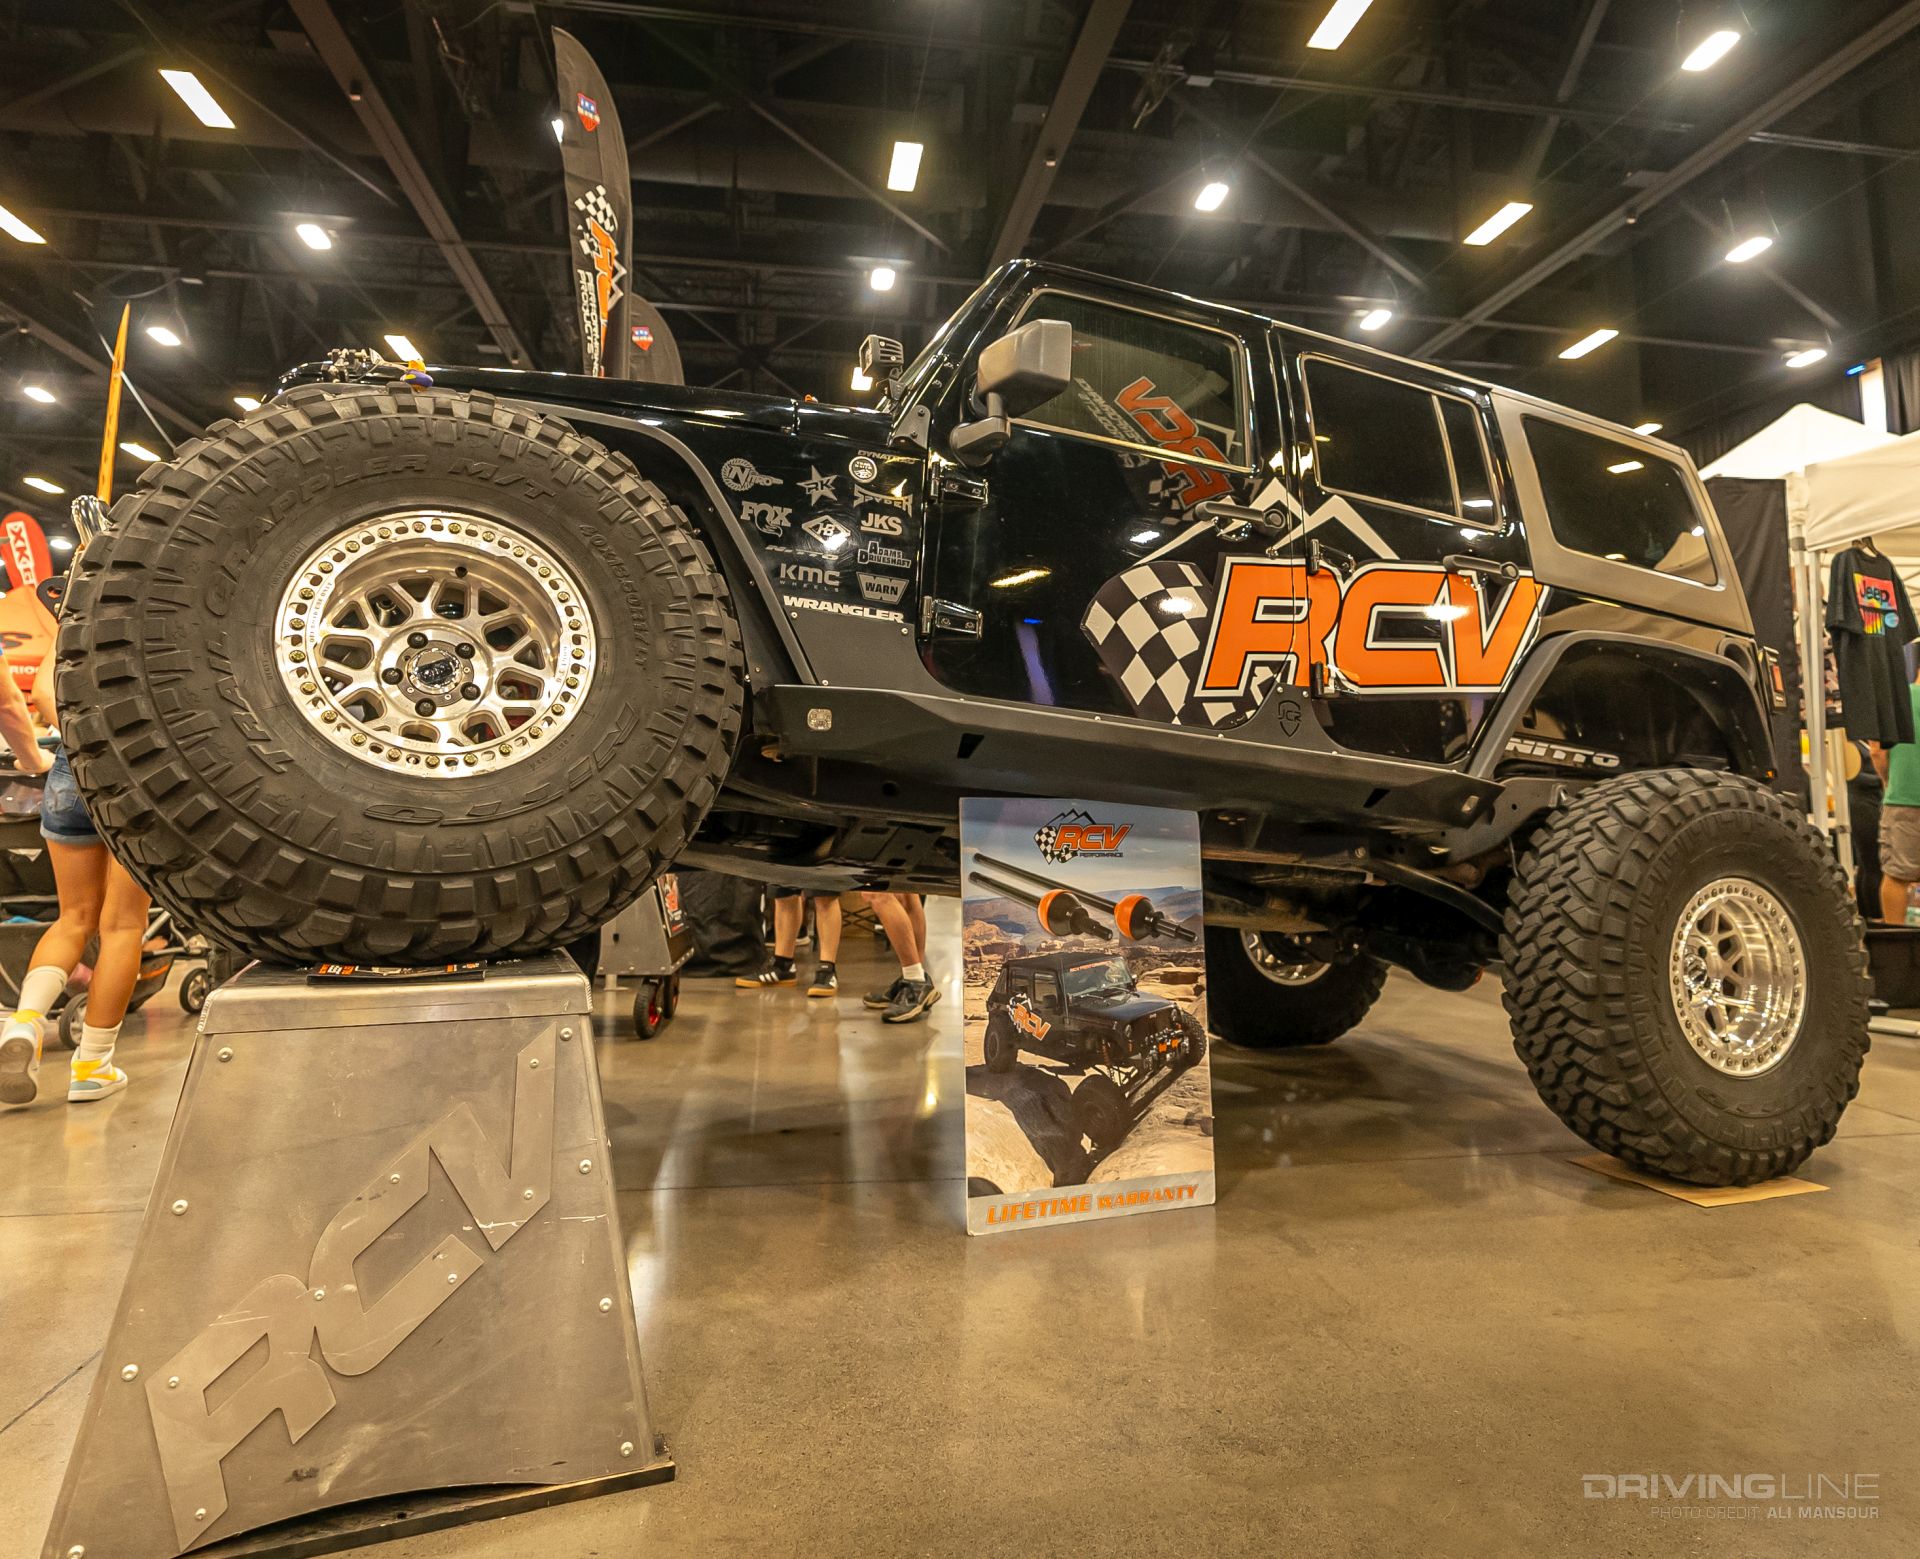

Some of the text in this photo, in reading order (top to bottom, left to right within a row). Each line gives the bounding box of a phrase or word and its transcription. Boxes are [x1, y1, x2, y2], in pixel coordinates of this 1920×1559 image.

[577, 269, 595, 358] PRODUCTS
[740, 500, 793, 537] FOX
[861, 512, 903, 536] JKS
[857, 549, 912, 568] DRIVESHAFT
[868, 541, 903, 559] ADAMS
[865, 582, 899, 596] WARN
[1860, 579, 1890, 604] Jeep
[783, 595, 904, 623] WRANGLER
[1193, 553, 1550, 700] RCV
[1504, 736, 1621, 769] NITTO
[1053, 822, 1134, 852] RCV
[1078, 851, 1124, 859] PERFORMANCE
[1011, 1003, 1052, 1042] RCV
[985, 1182, 1201, 1226] LIFETIME WARRANTY
[144, 1022, 559, 1554] RCV
